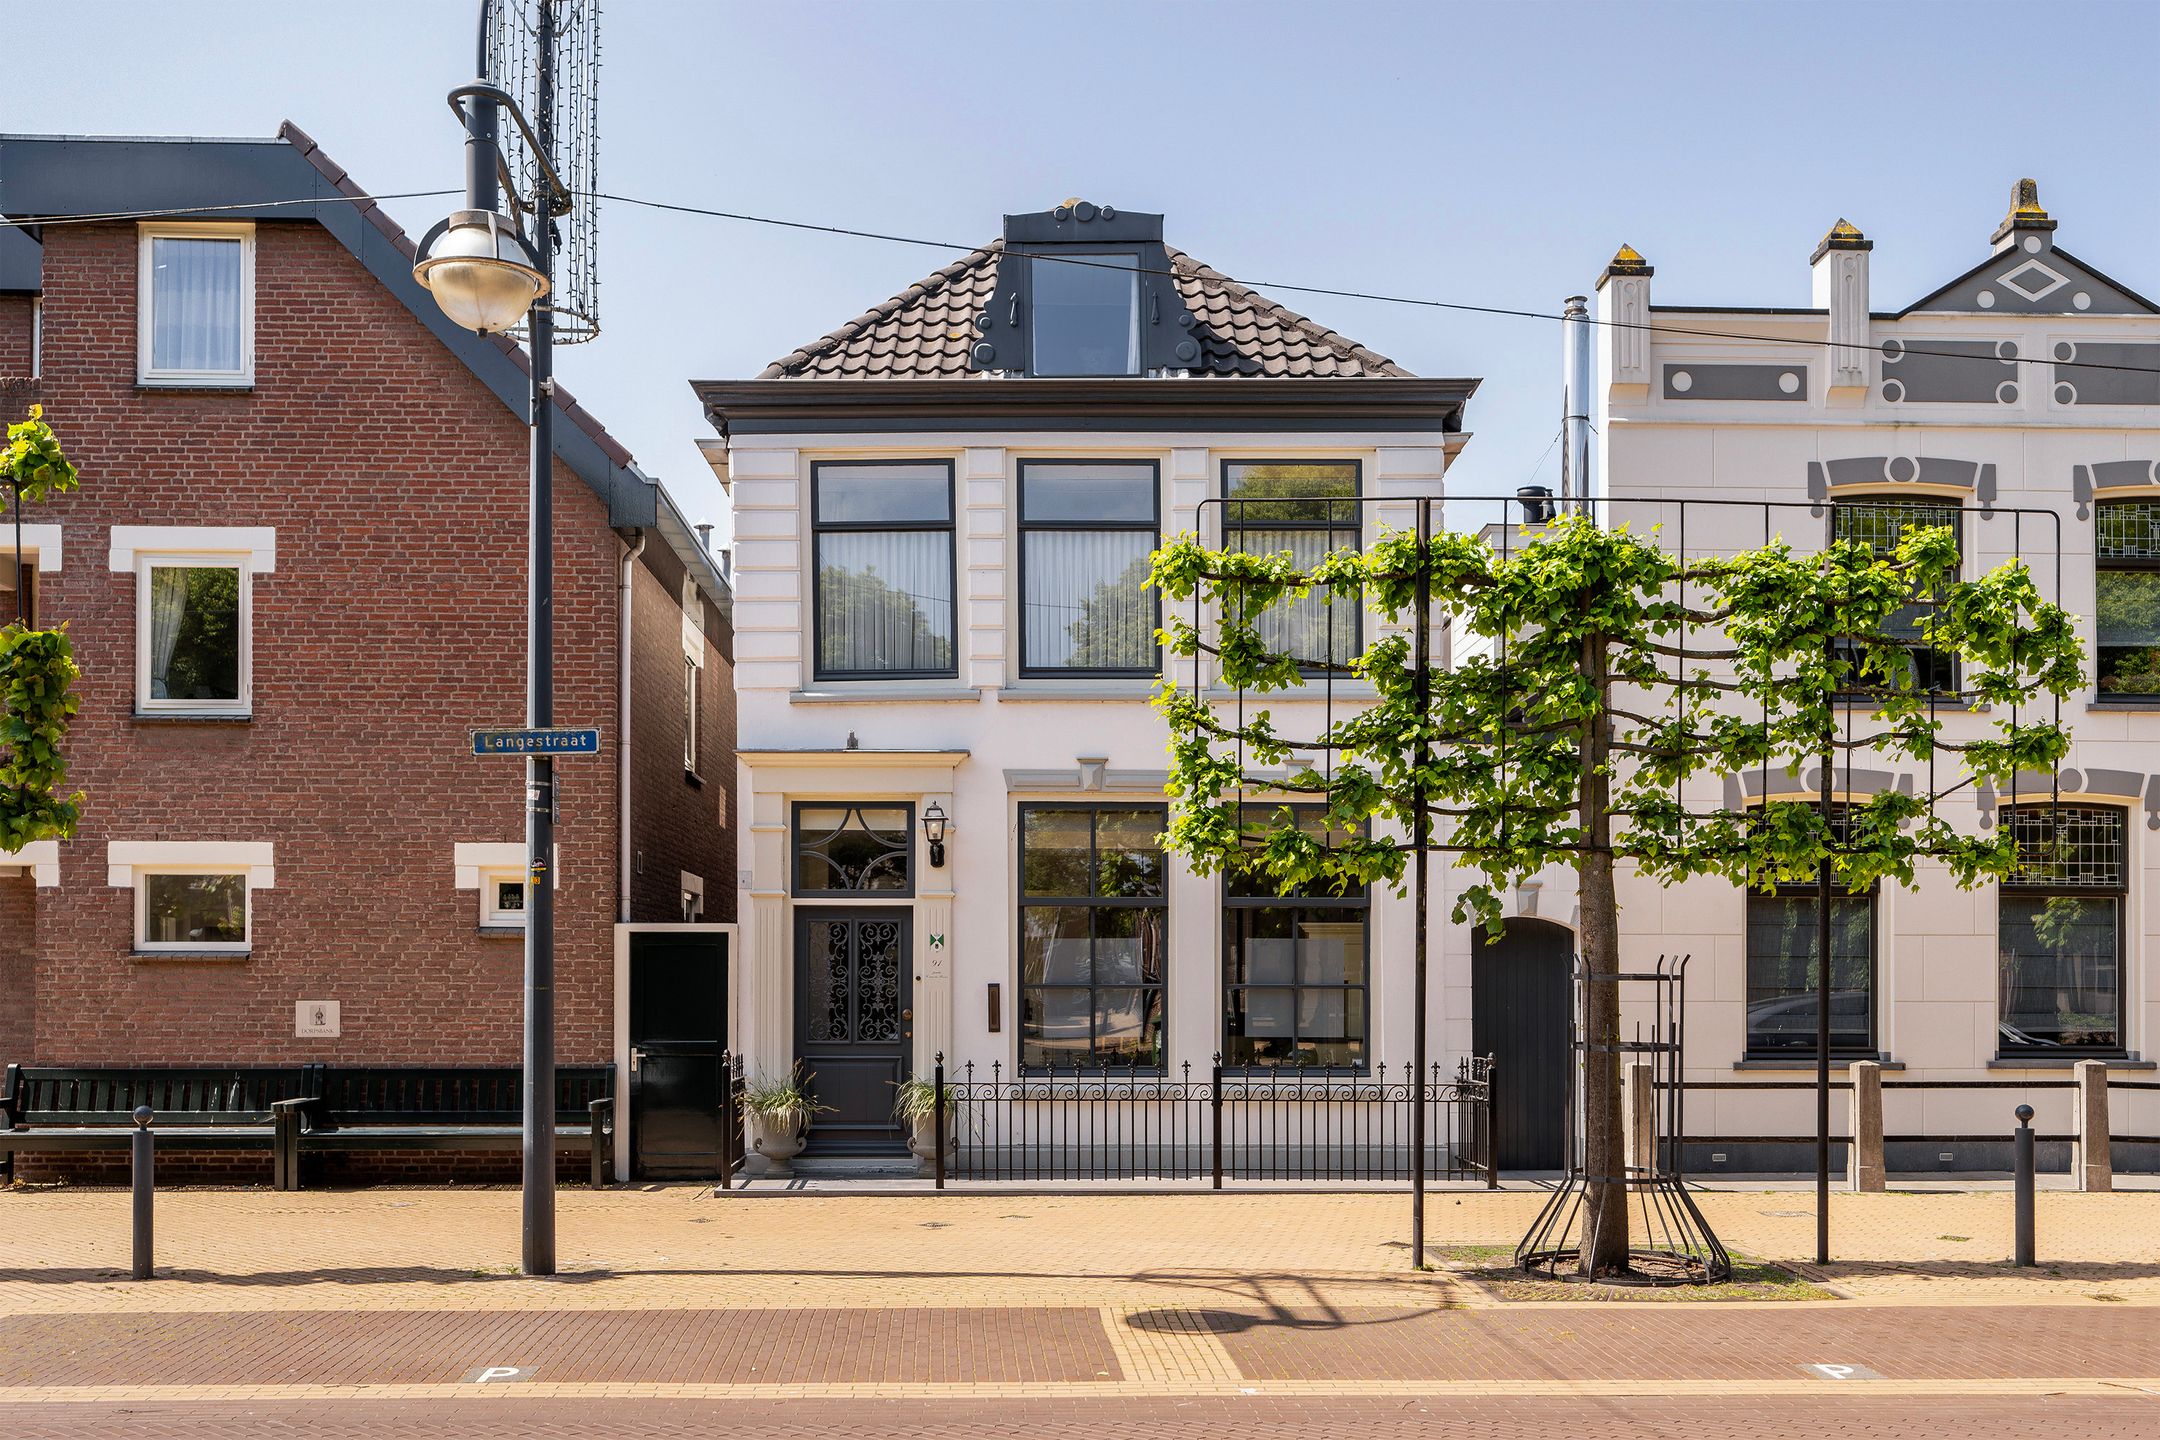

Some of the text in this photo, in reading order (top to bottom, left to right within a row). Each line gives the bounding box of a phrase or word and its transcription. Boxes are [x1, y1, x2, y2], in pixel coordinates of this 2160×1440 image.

[485, 735, 586, 750] Langestraat
[475, 1367, 520, 1383] P
[1812, 1363, 1854, 1379] P
